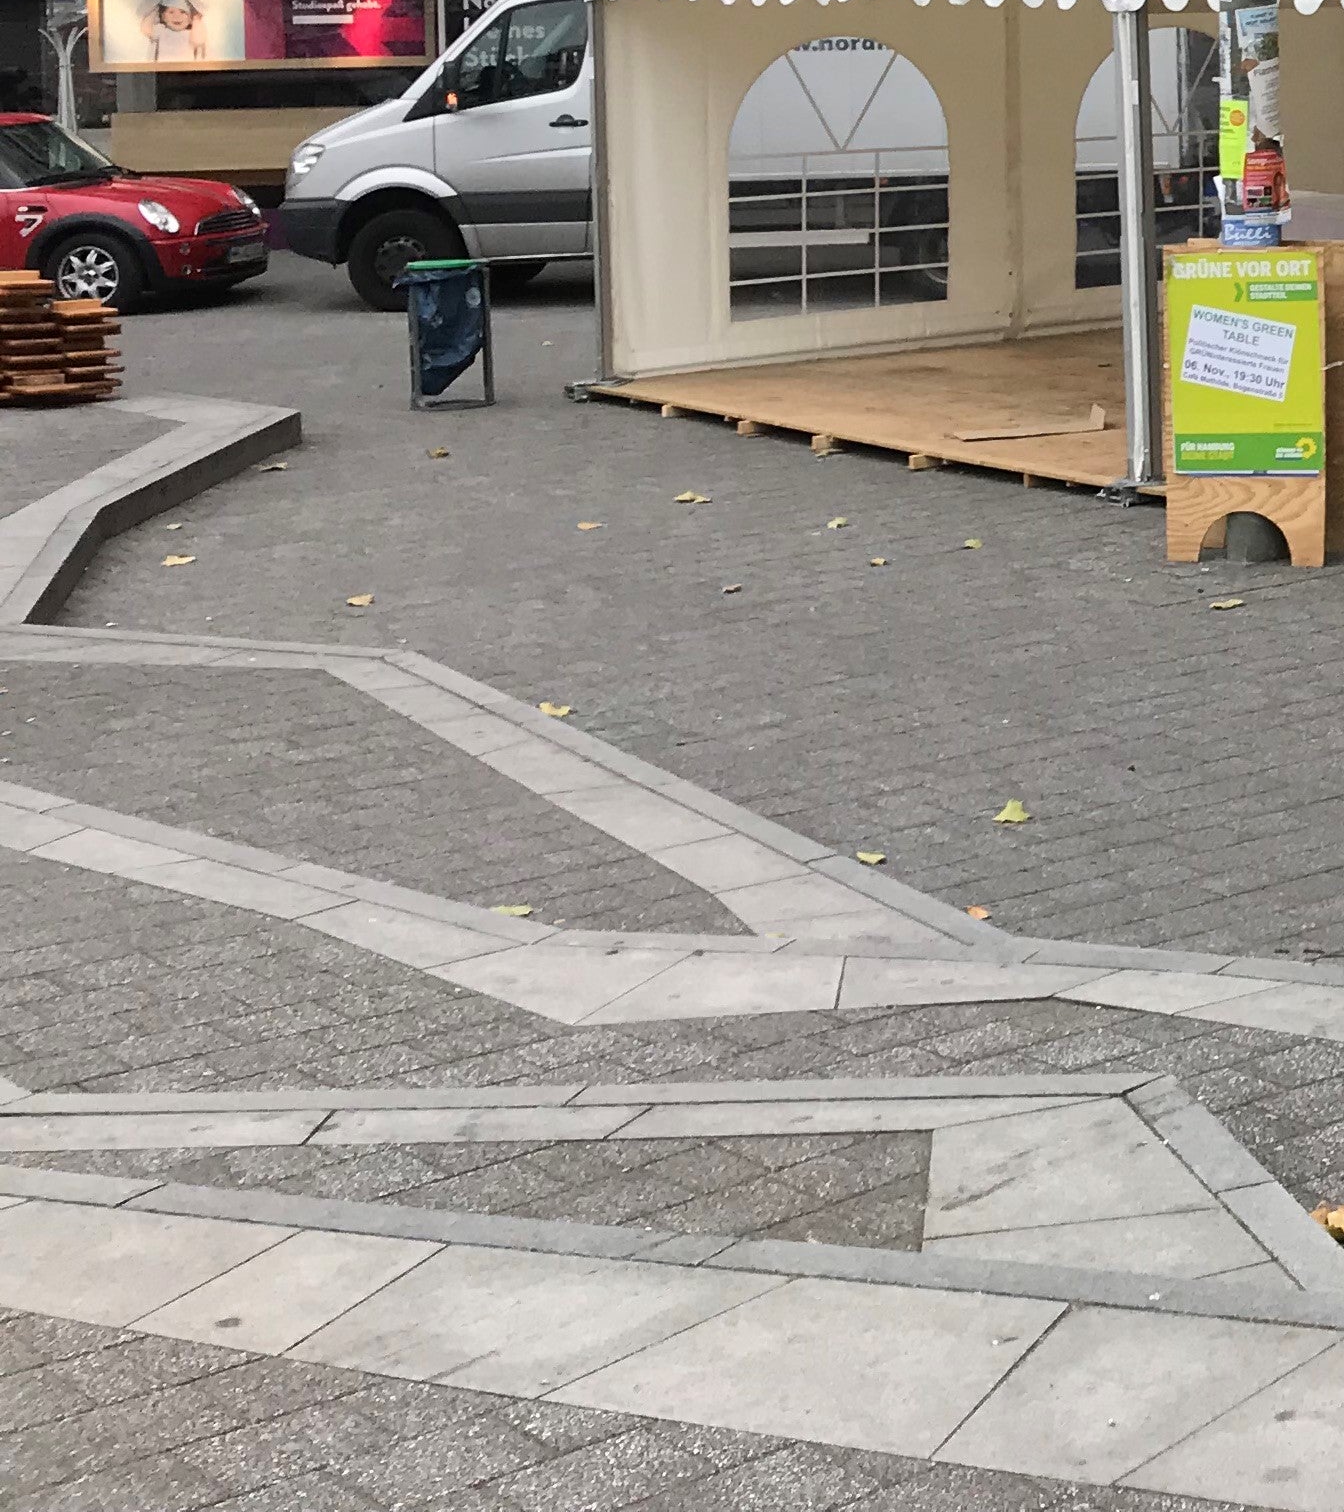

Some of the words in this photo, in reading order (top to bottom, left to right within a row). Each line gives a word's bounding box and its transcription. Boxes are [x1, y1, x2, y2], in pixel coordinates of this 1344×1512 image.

[1172, 258, 1233, 280] GRÜNE
[1235, 260, 1272, 278] VOR
[1275, 259, 1312, 278] ORT
[1193, 308, 1249, 330] WOMEN'S
[1252, 321, 1294, 339] GREEN
[1222, 329, 1261, 346] TABLE
[1265, 376, 1286, 390] Uhr
